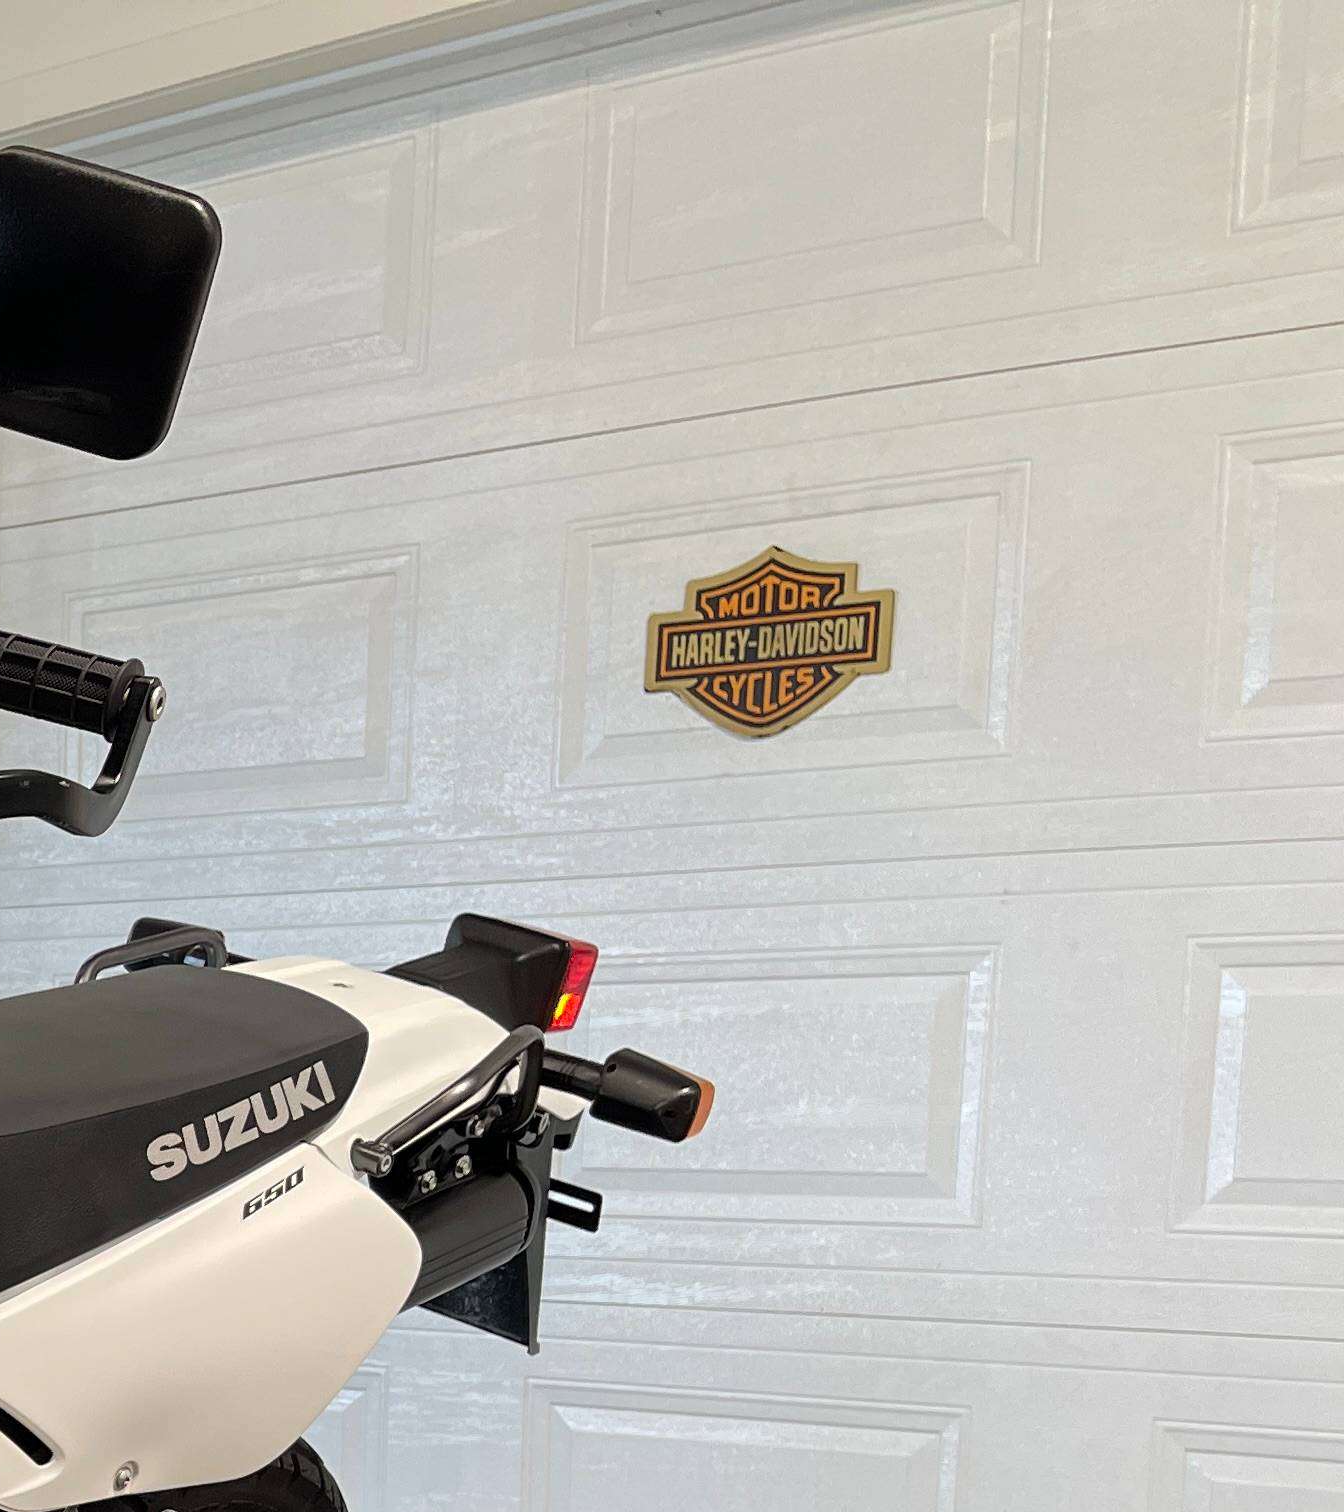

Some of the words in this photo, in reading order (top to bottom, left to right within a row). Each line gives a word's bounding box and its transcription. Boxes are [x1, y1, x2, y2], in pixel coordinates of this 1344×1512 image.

[718, 575, 820, 618] MOTOR
[671, 615, 865, 667] HARLEY-DAVIDSON
[713, 666, 814, 715] CYCLES
[146, 1060, 335, 1182] SUZUKI
[242, 1166, 304, 1220] 650
